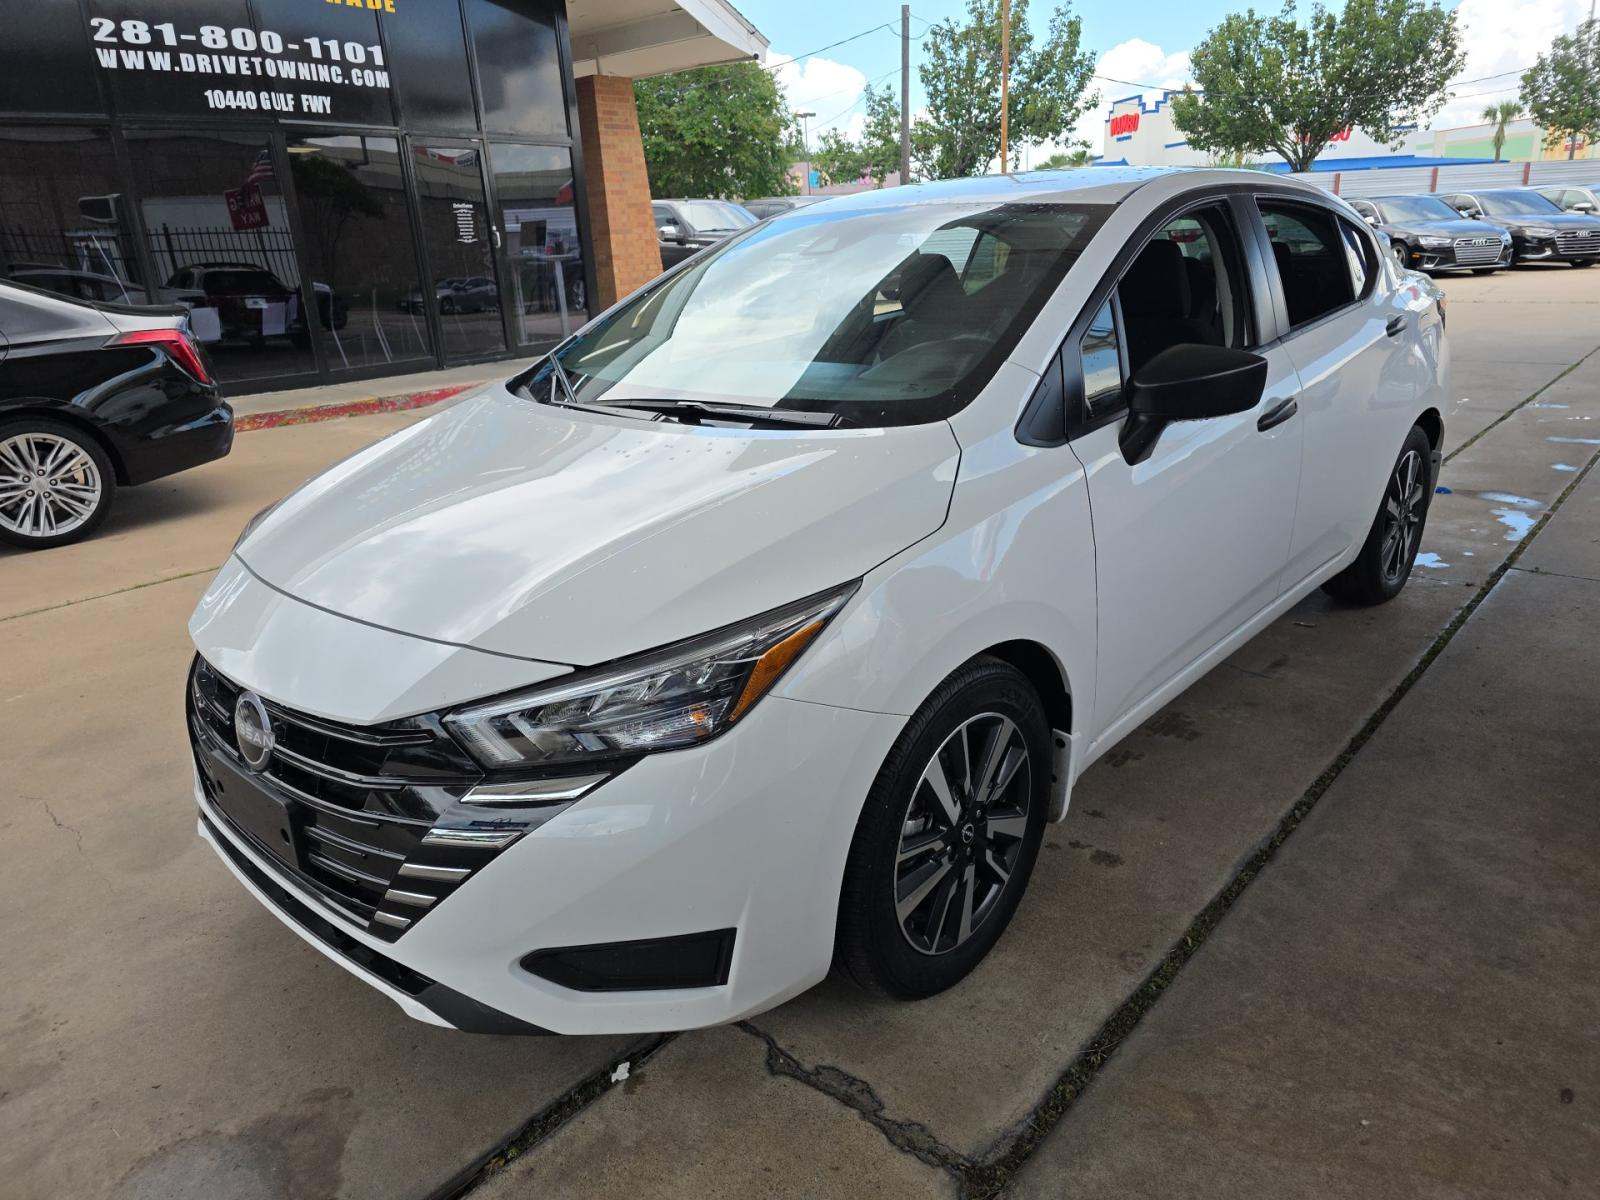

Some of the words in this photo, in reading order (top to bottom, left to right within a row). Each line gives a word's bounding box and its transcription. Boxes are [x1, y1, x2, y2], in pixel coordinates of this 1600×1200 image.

[90, 17, 385, 66] 281-800-1101
[95, 47, 390, 89] WWW.DRIVETOWNINC.COM
[204, 89, 257, 111] 10440
[259, 91, 295, 112] GULF
[300, 94, 332, 114] FWY
